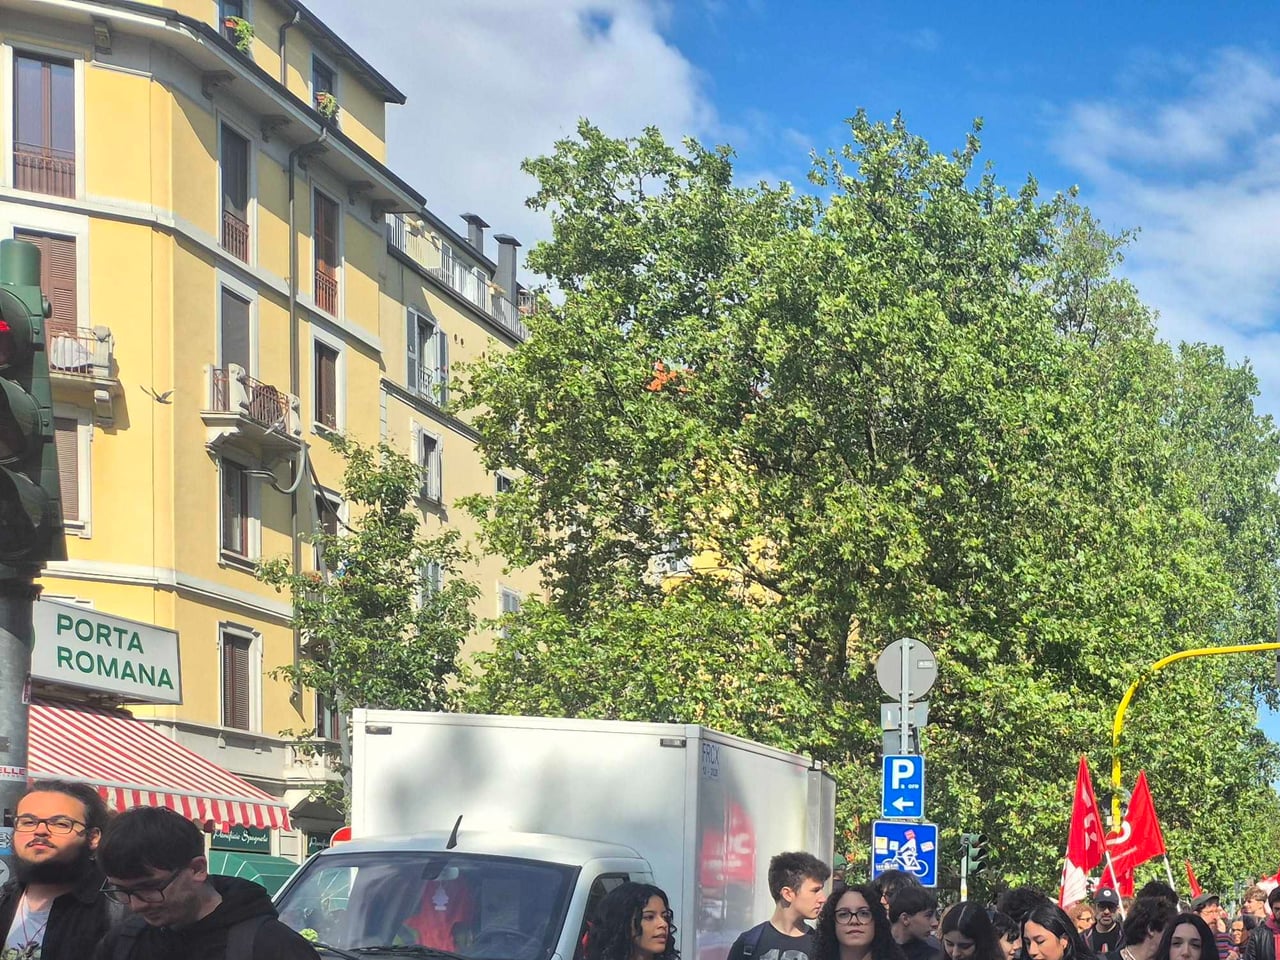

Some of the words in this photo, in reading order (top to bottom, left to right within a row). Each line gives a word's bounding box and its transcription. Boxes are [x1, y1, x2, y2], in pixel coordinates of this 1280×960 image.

[57, 613, 144, 654] PORTA
[57, 645, 174, 690] ROMANA
[891, 759, 915, 790] P
